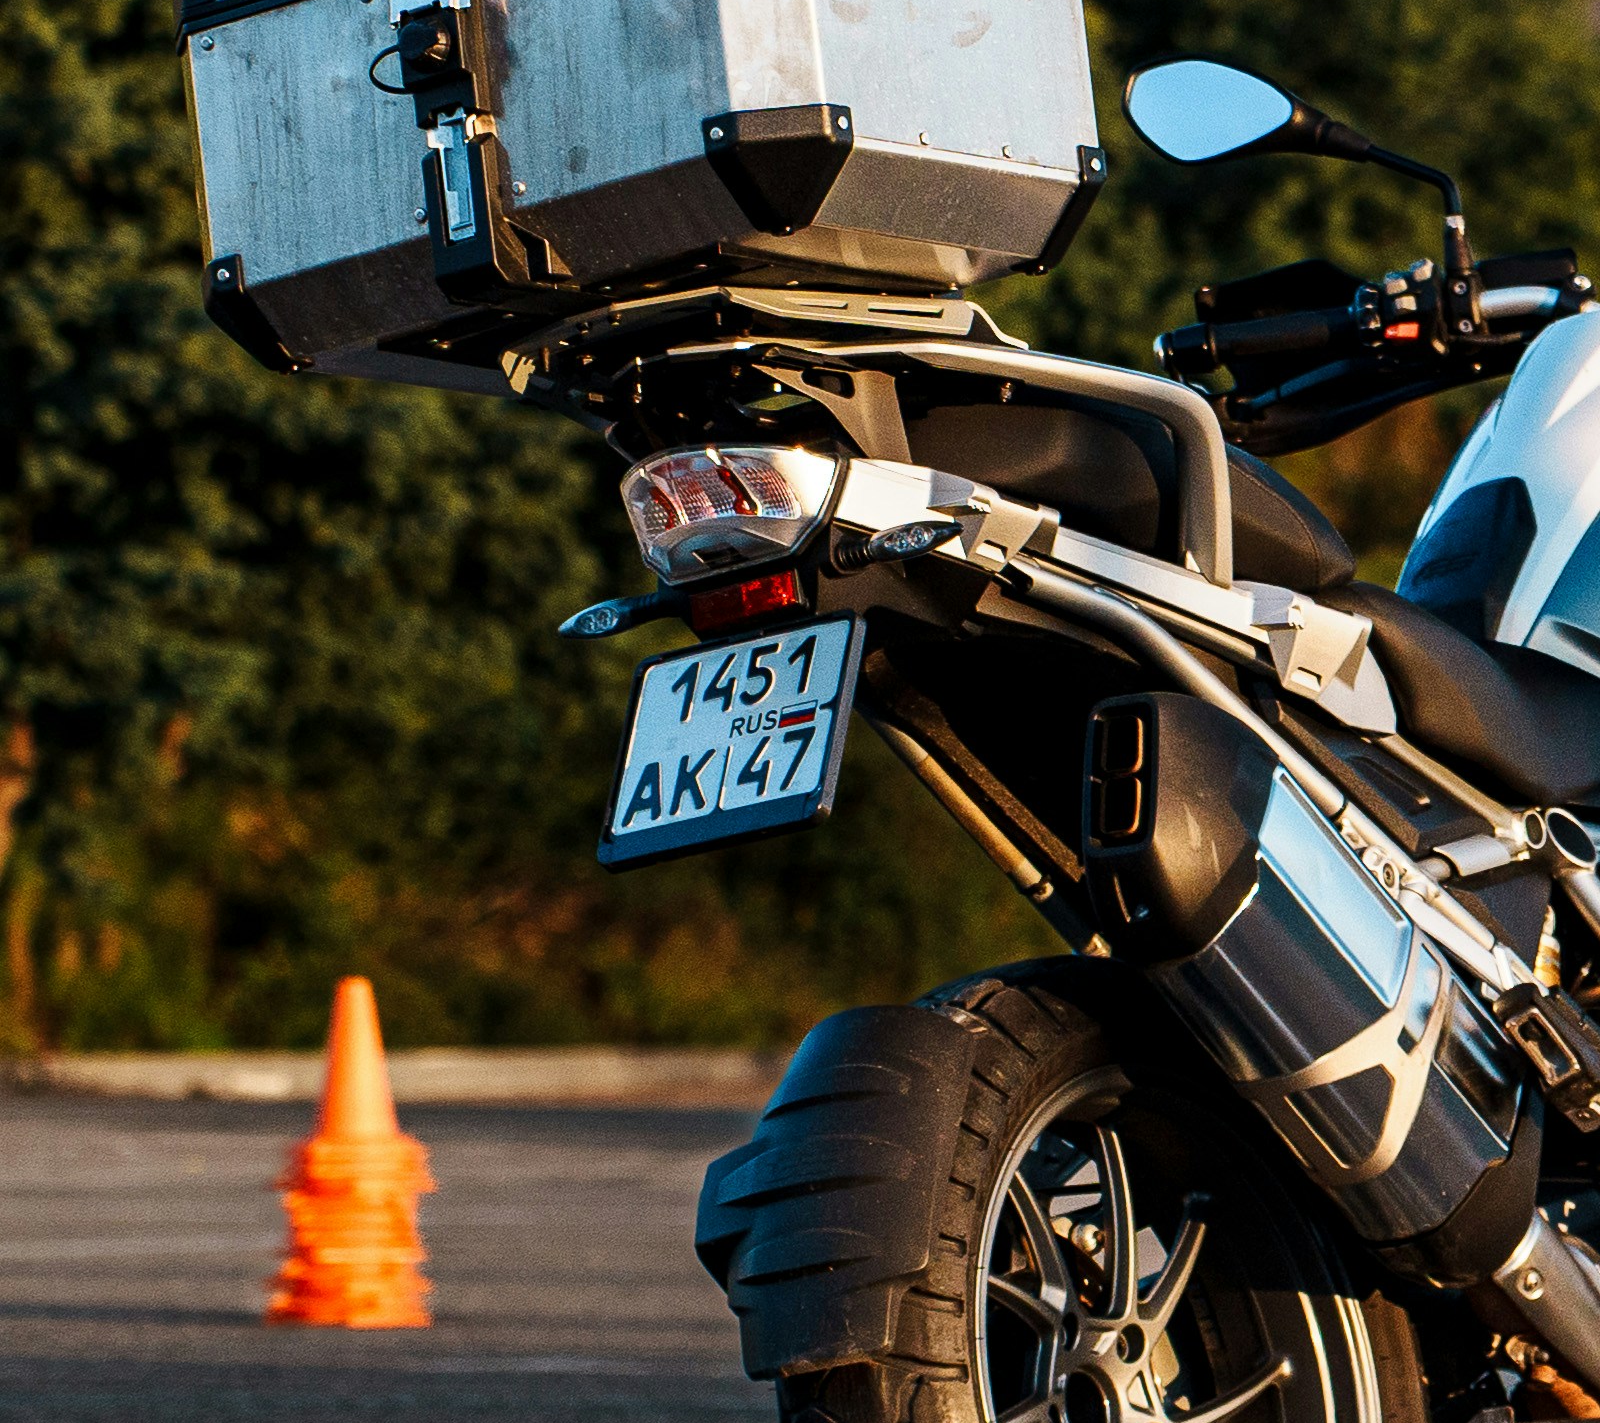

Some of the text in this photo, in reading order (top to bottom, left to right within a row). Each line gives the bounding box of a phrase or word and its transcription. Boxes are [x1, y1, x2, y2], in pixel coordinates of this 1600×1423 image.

[672, 634, 818, 723] 1451
[730, 709, 778, 736] RUS
[737, 726, 816, 797] 47
